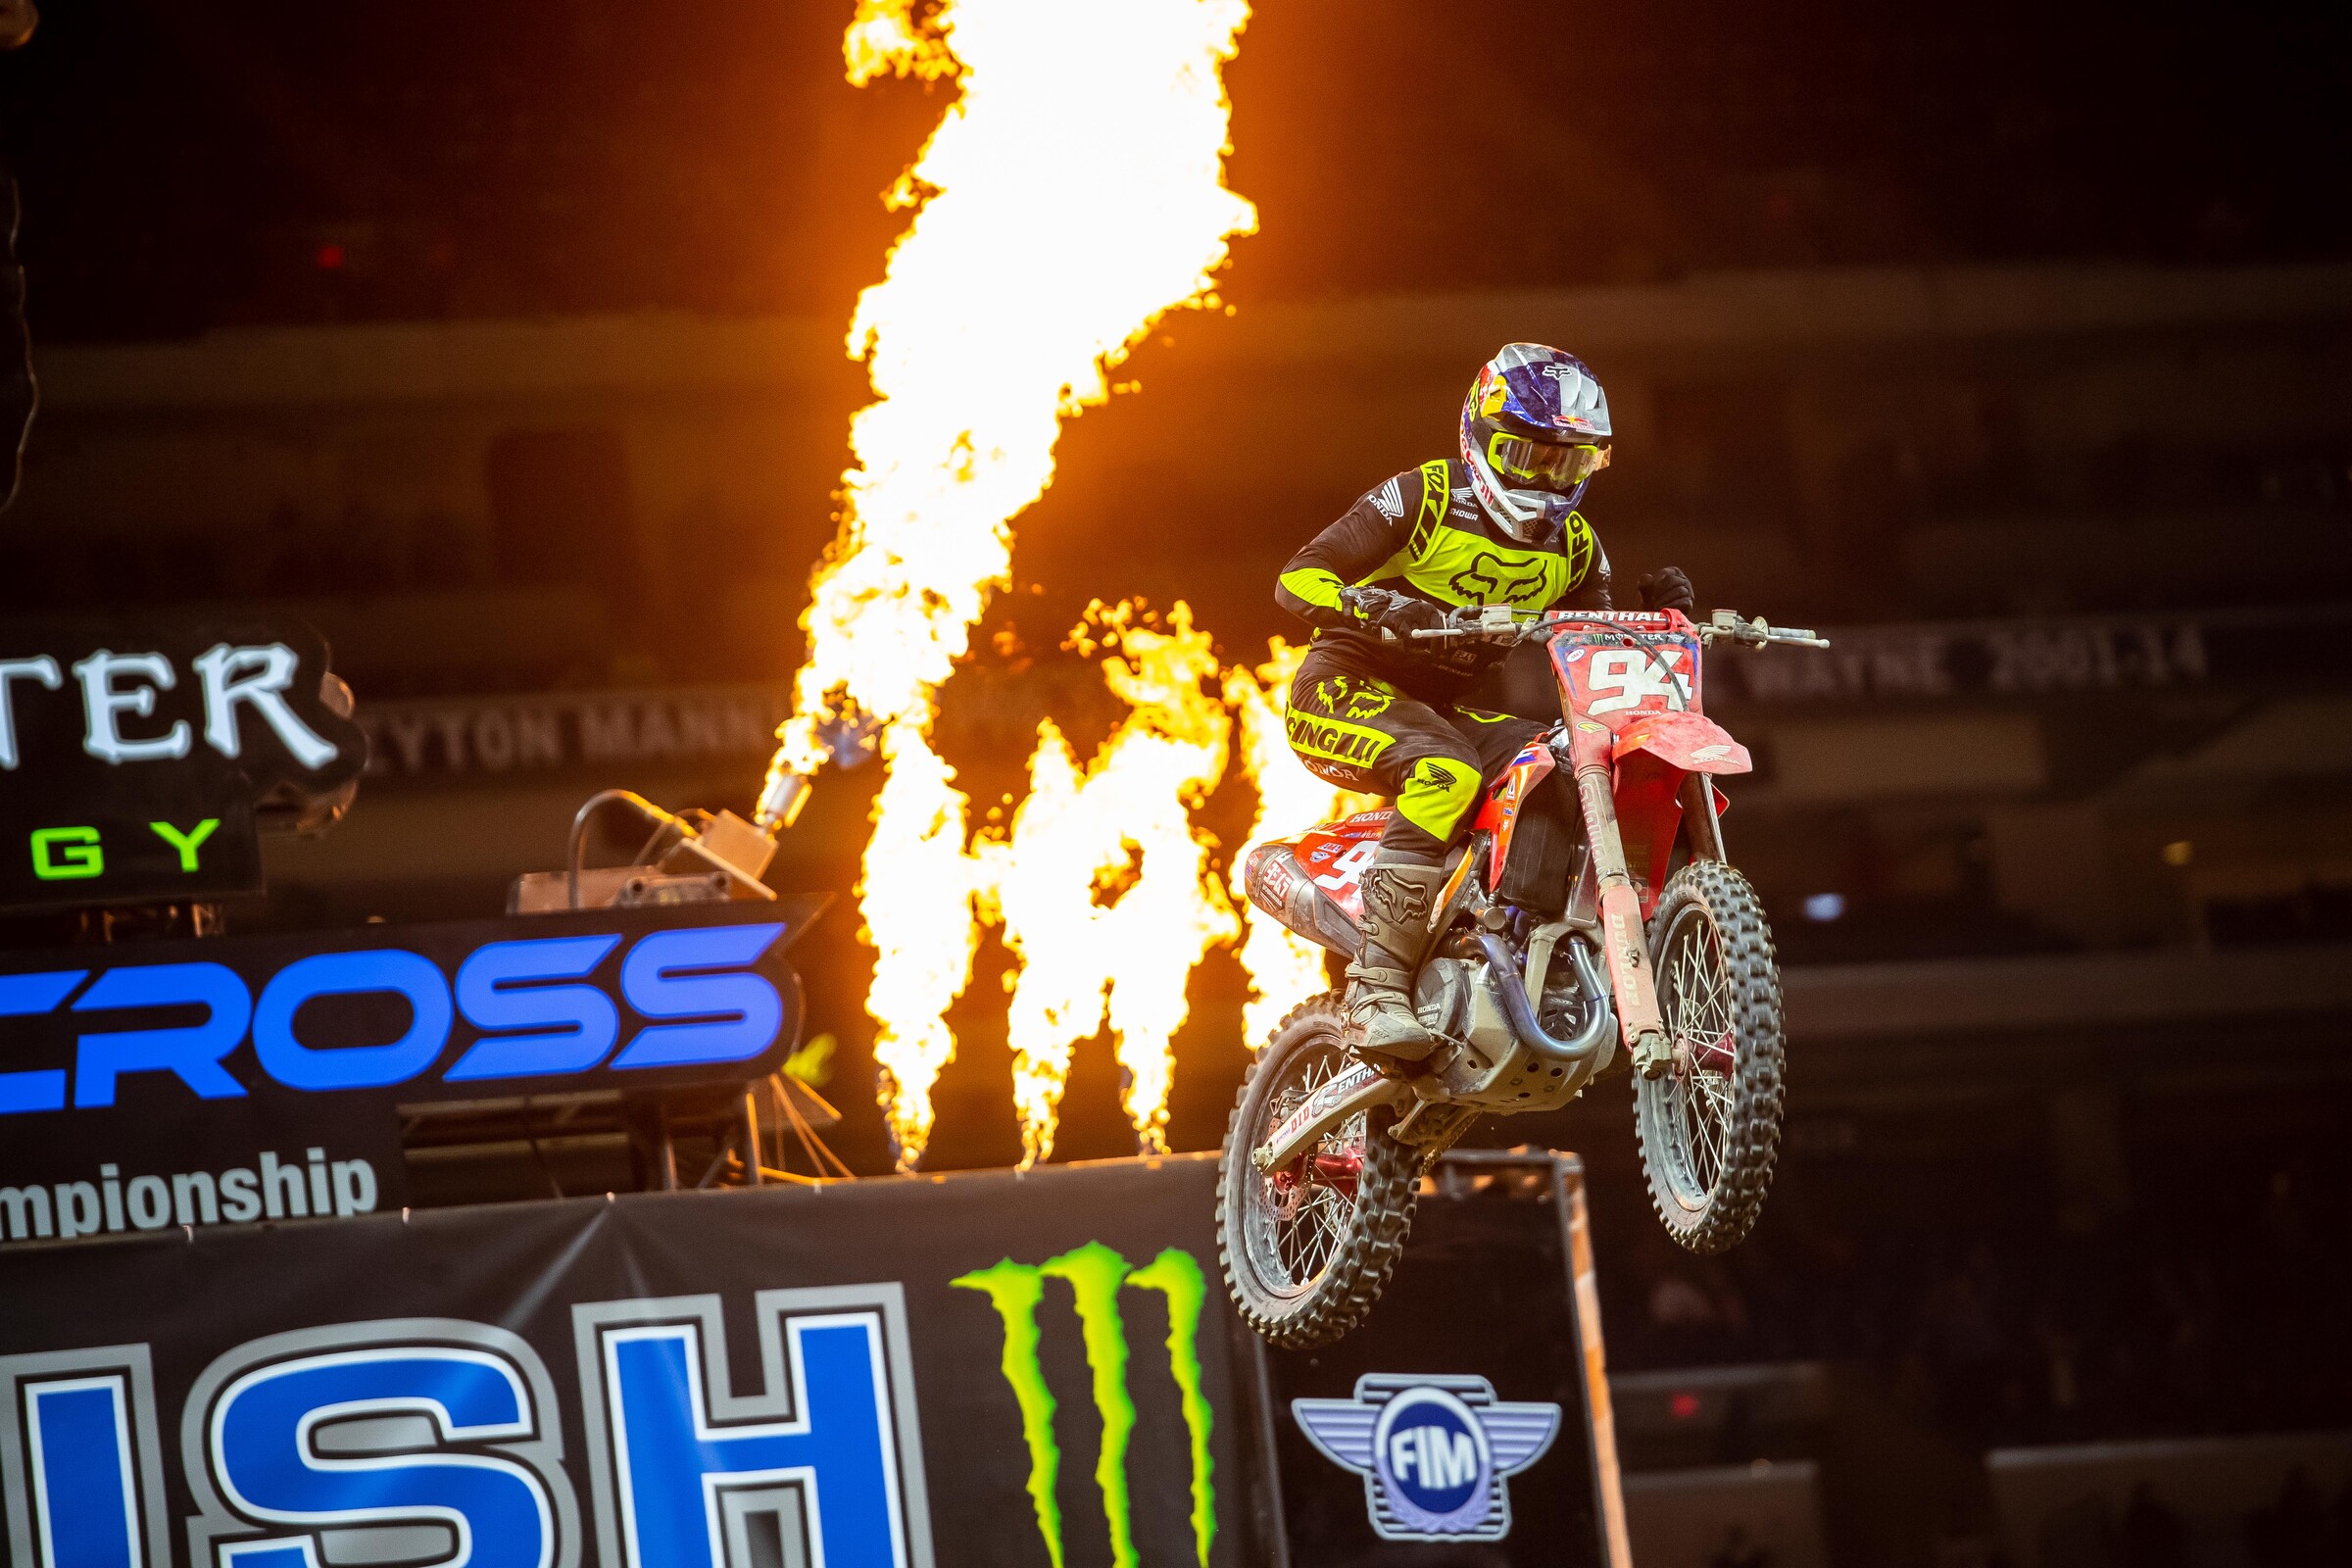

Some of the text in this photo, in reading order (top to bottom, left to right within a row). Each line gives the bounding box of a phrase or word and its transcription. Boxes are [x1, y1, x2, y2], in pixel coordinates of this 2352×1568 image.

[1449, 508, 1479, 521] SHOWA
[1558, 612, 1668, 621] RENTHAL
[1604, 632, 1664, 641] MOTER
[1588, 649, 1693, 716] 94
[30, 818, 220, 880] GY
[1313, 840, 1381, 904] 9
[1416, 1003, 1441, 1015] HONDA
[1291, 1106, 1310, 1134] DID
[0, 1281, 936, 1568] ISH
[1389, 1425, 1477, 1490] FIM
